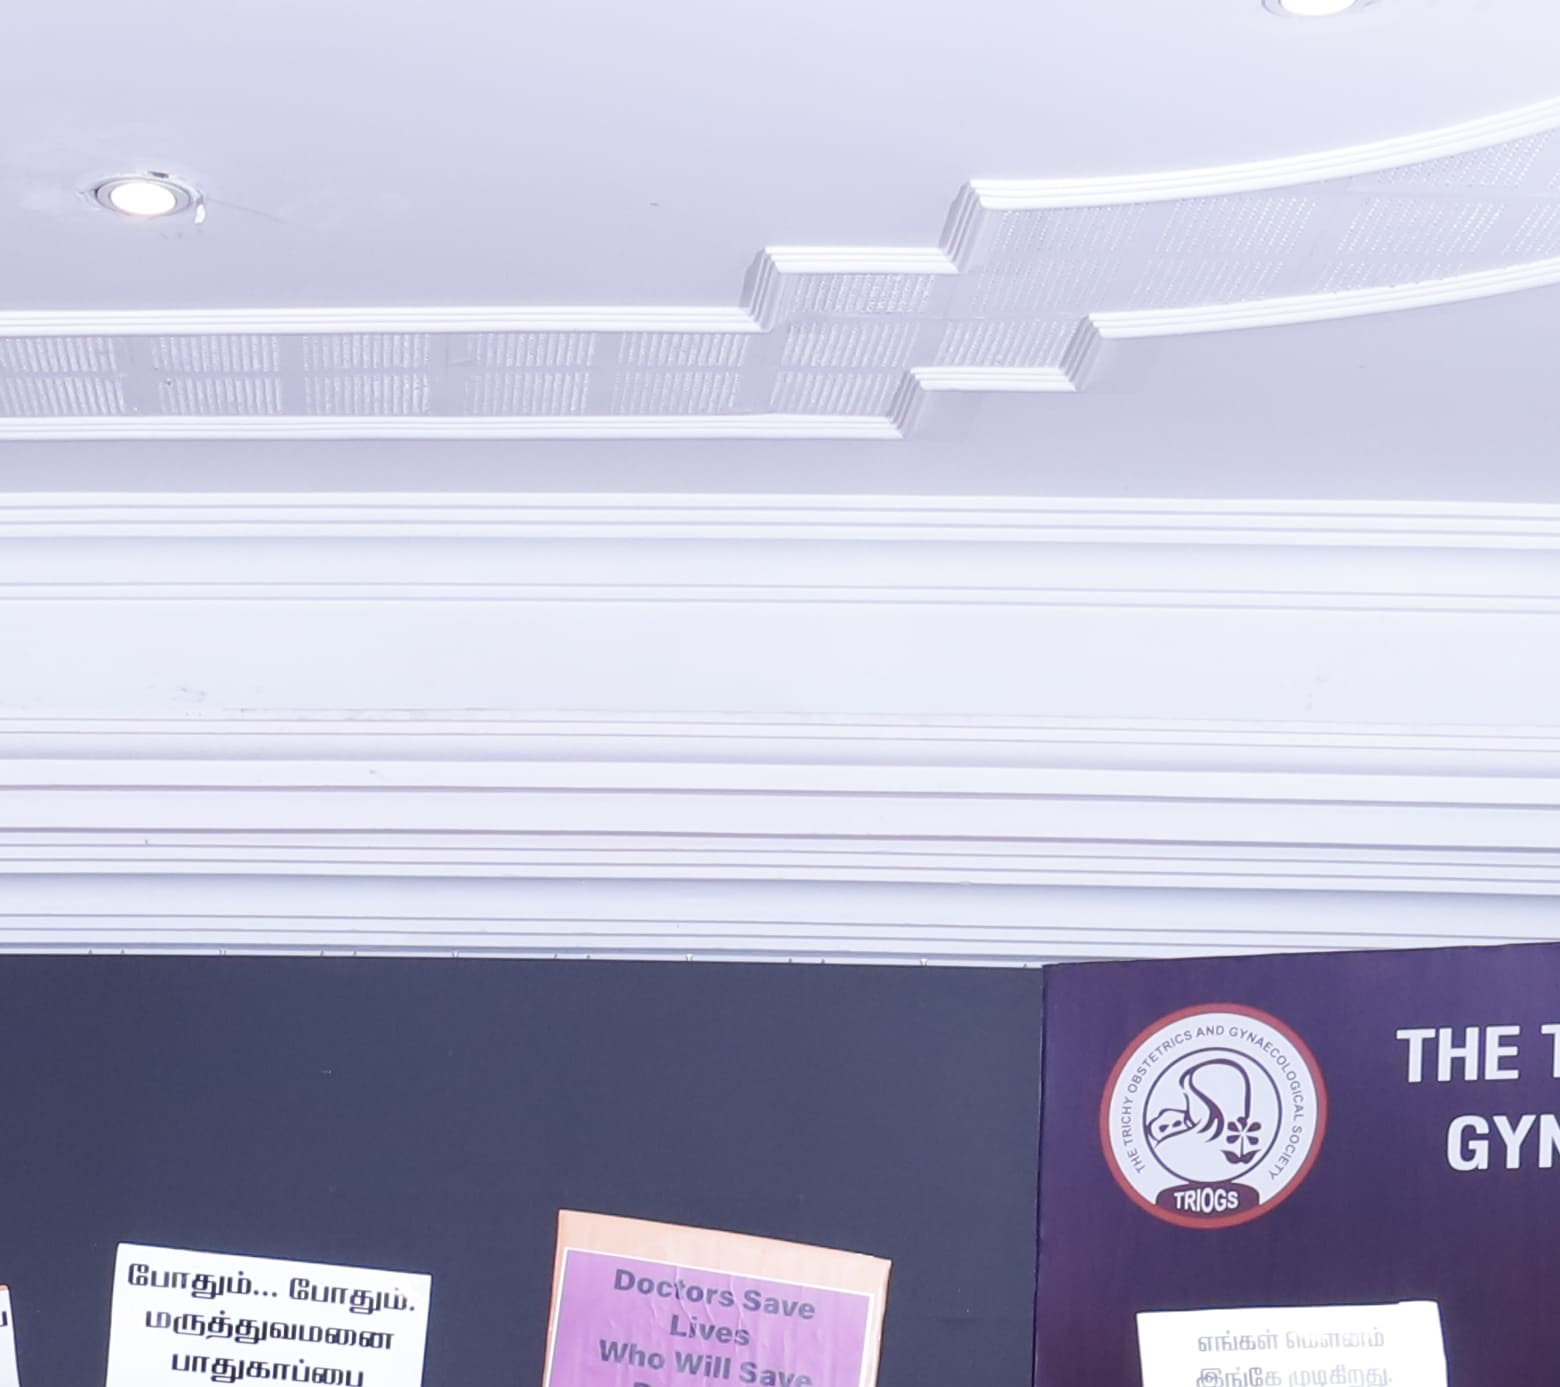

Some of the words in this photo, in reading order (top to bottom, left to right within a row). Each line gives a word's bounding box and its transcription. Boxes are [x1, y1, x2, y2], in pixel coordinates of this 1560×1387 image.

[1396, 1024, 1521, 1083] THE
[1174, 1188, 1238, 1213] TRIOGS
[614, 1269, 734, 1307] Doctors
[743, 1290, 815, 1320] Save
[145, 1310, 394, 1350] மருத்துவமனை
[669, 1315, 750, 1346] Lives
[171, 1353, 364, 1387] பாதுகாப்பை
[599, 1339, 665, 1370] Who
[676, 1351, 731, 1379] Will
